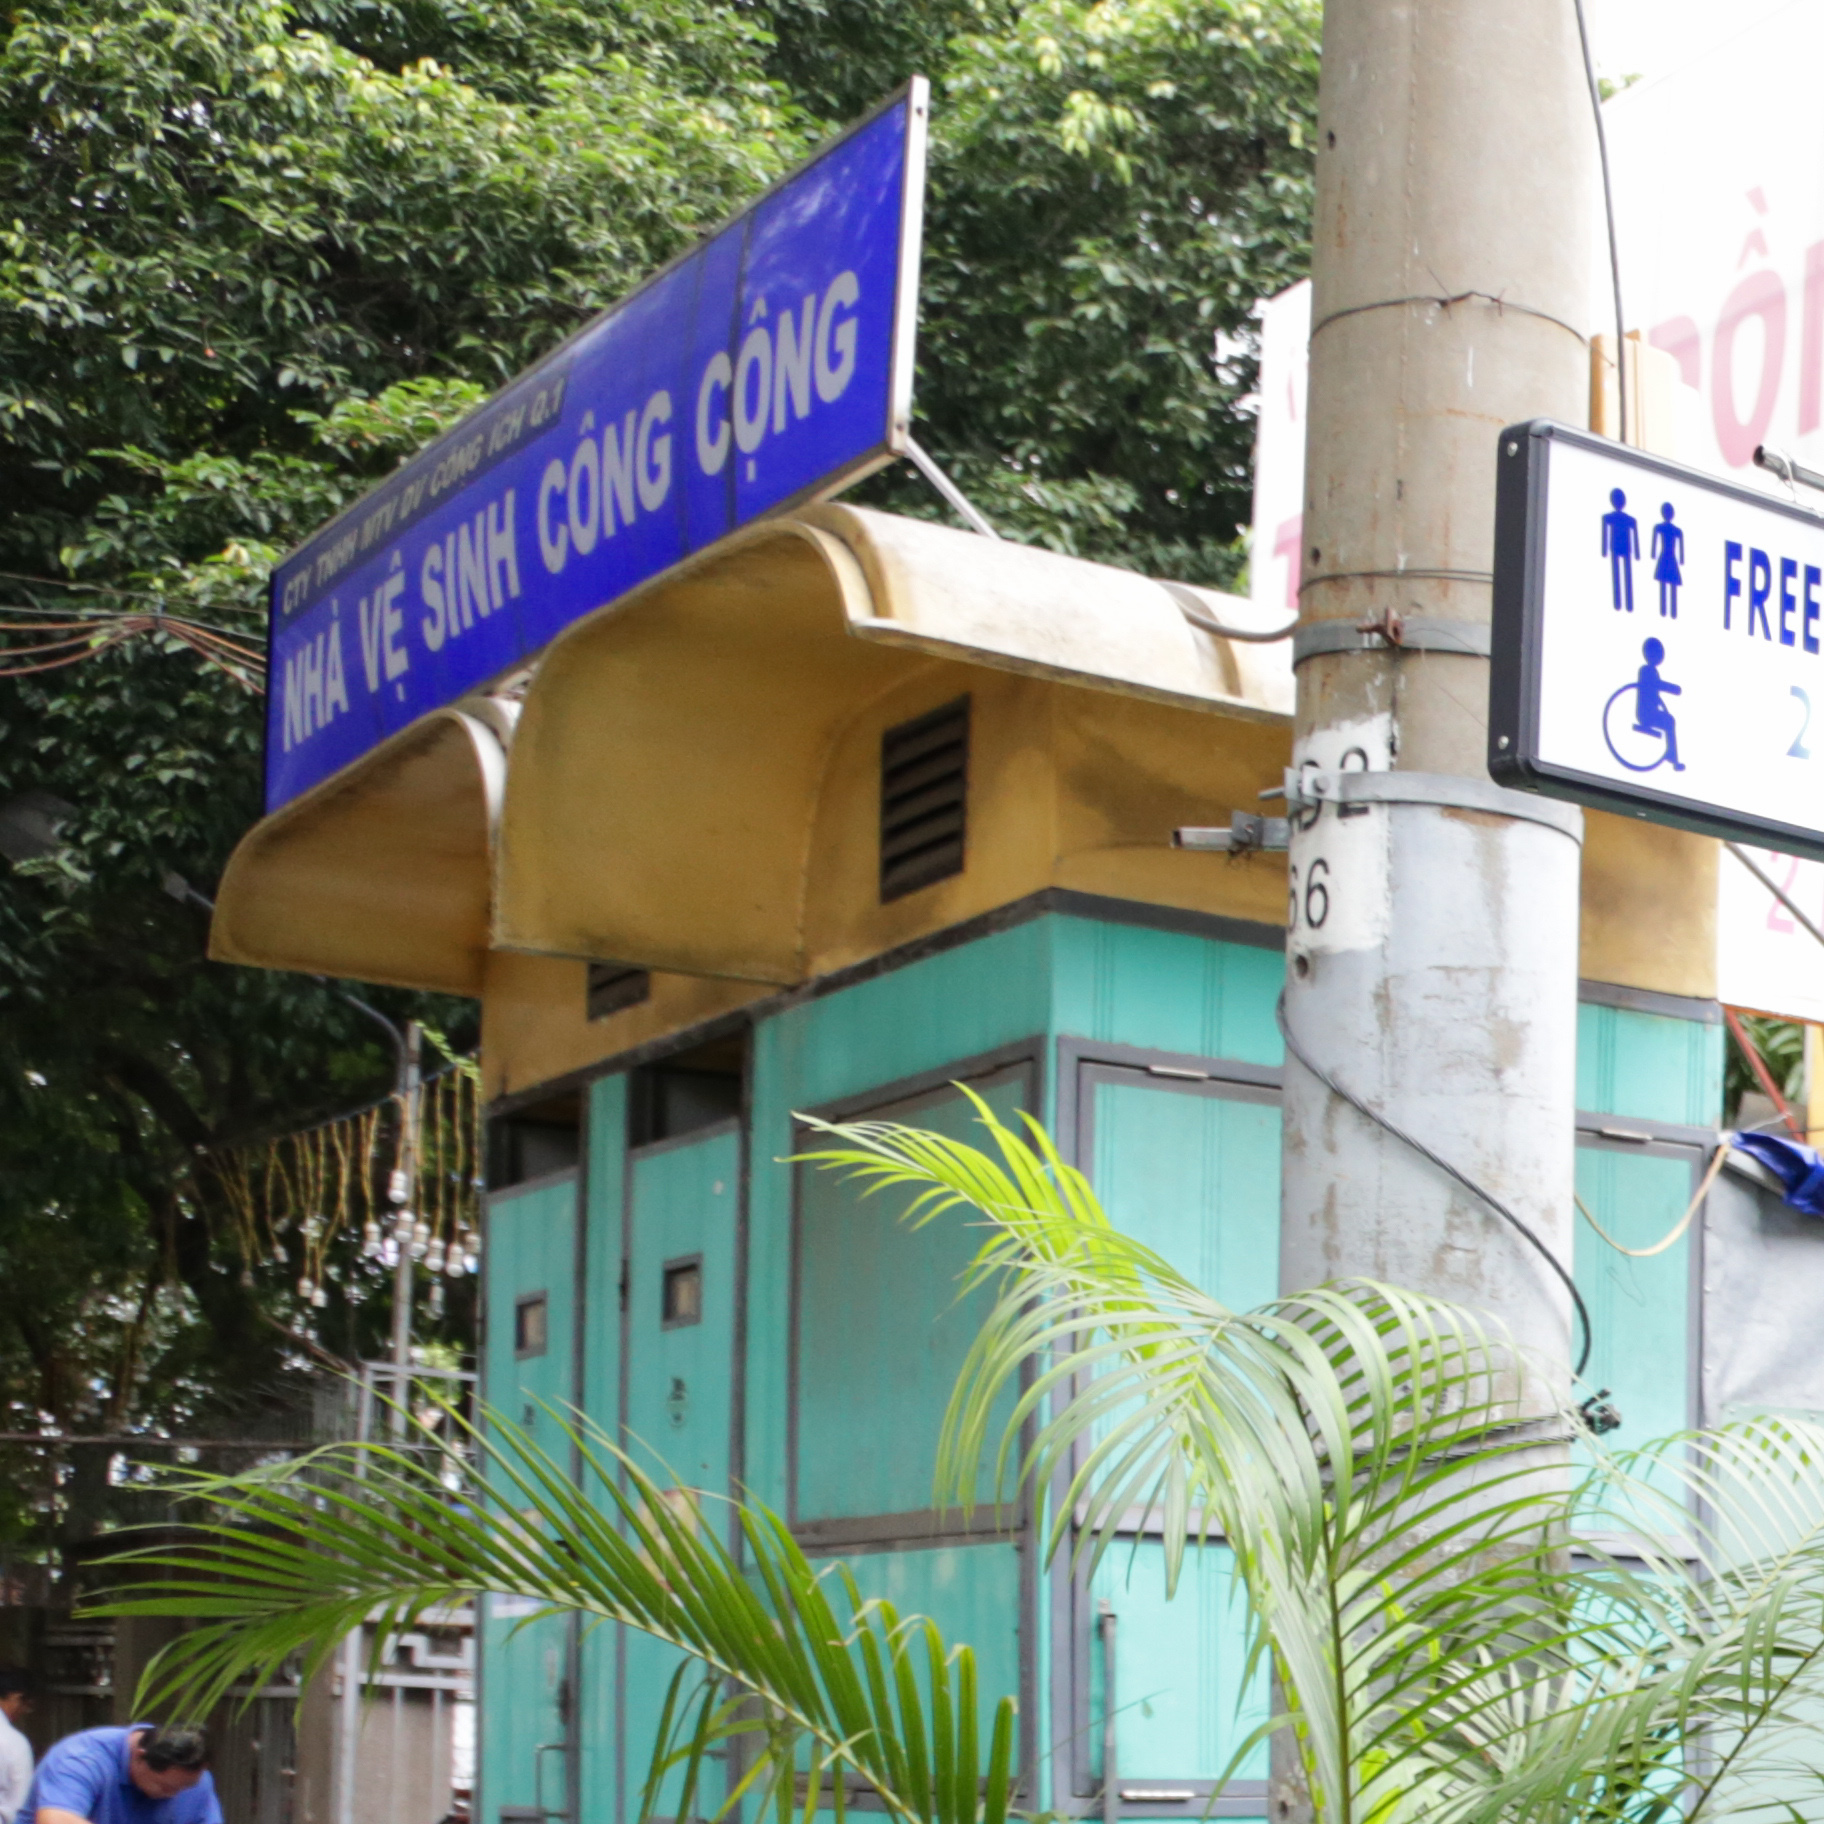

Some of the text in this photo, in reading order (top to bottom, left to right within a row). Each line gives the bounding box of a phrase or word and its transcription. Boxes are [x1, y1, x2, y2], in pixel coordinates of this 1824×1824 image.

[282, 269, 860, 753] NHÀ VỆ SINH CÔNG CỘNG
[1723, 539, 1821, 656] FREE
